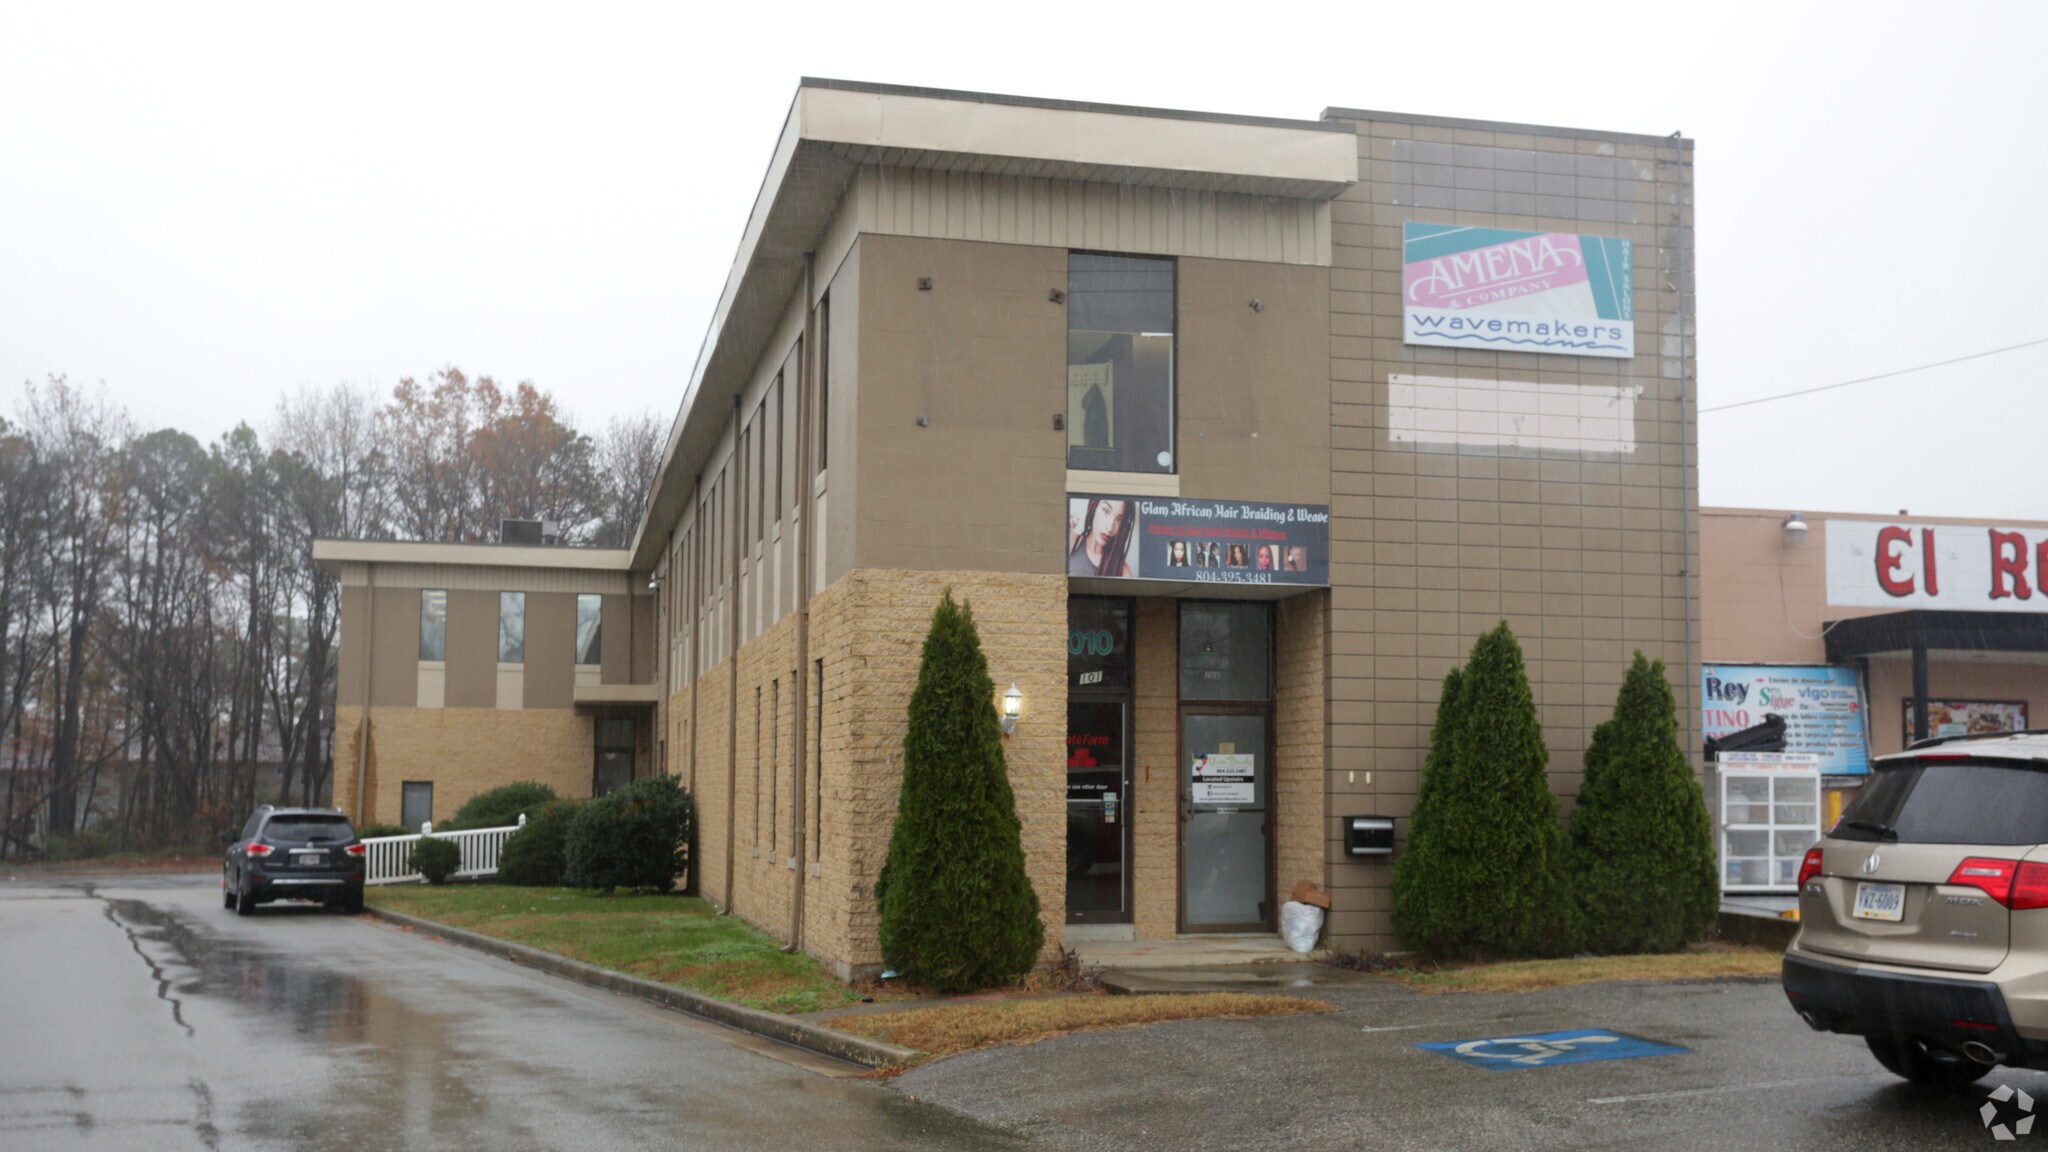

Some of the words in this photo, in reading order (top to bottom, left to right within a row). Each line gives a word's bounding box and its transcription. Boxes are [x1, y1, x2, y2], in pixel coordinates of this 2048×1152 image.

[1408, 236, 1582, 302] AMENA
[1622, 240, 1630, 269] HAIR
[1449, 299, 1462, 309] &
[1466, 278, 1552, 306] COMPANY
[1622, 274, 1631, 320] SALONS
[1411, 313, 1622, 341] wavemakers
[1141, 502, 1168, 517] Glam
[1171, 502, 1213, 519] African
[1214, 504, 1239, 519] Hair
[1241, 505, 1286, 525] Braiding
[1287, 508, 1295, 522] &
[1296, 509, 1328, 523] Weave
[1195, 570, 1272, 583] 804-325-3481
[1874, 526, 1939, 598] El
[1082, 671, 1101, 683] 101
[1705, 677, 1749, 706] Rey
